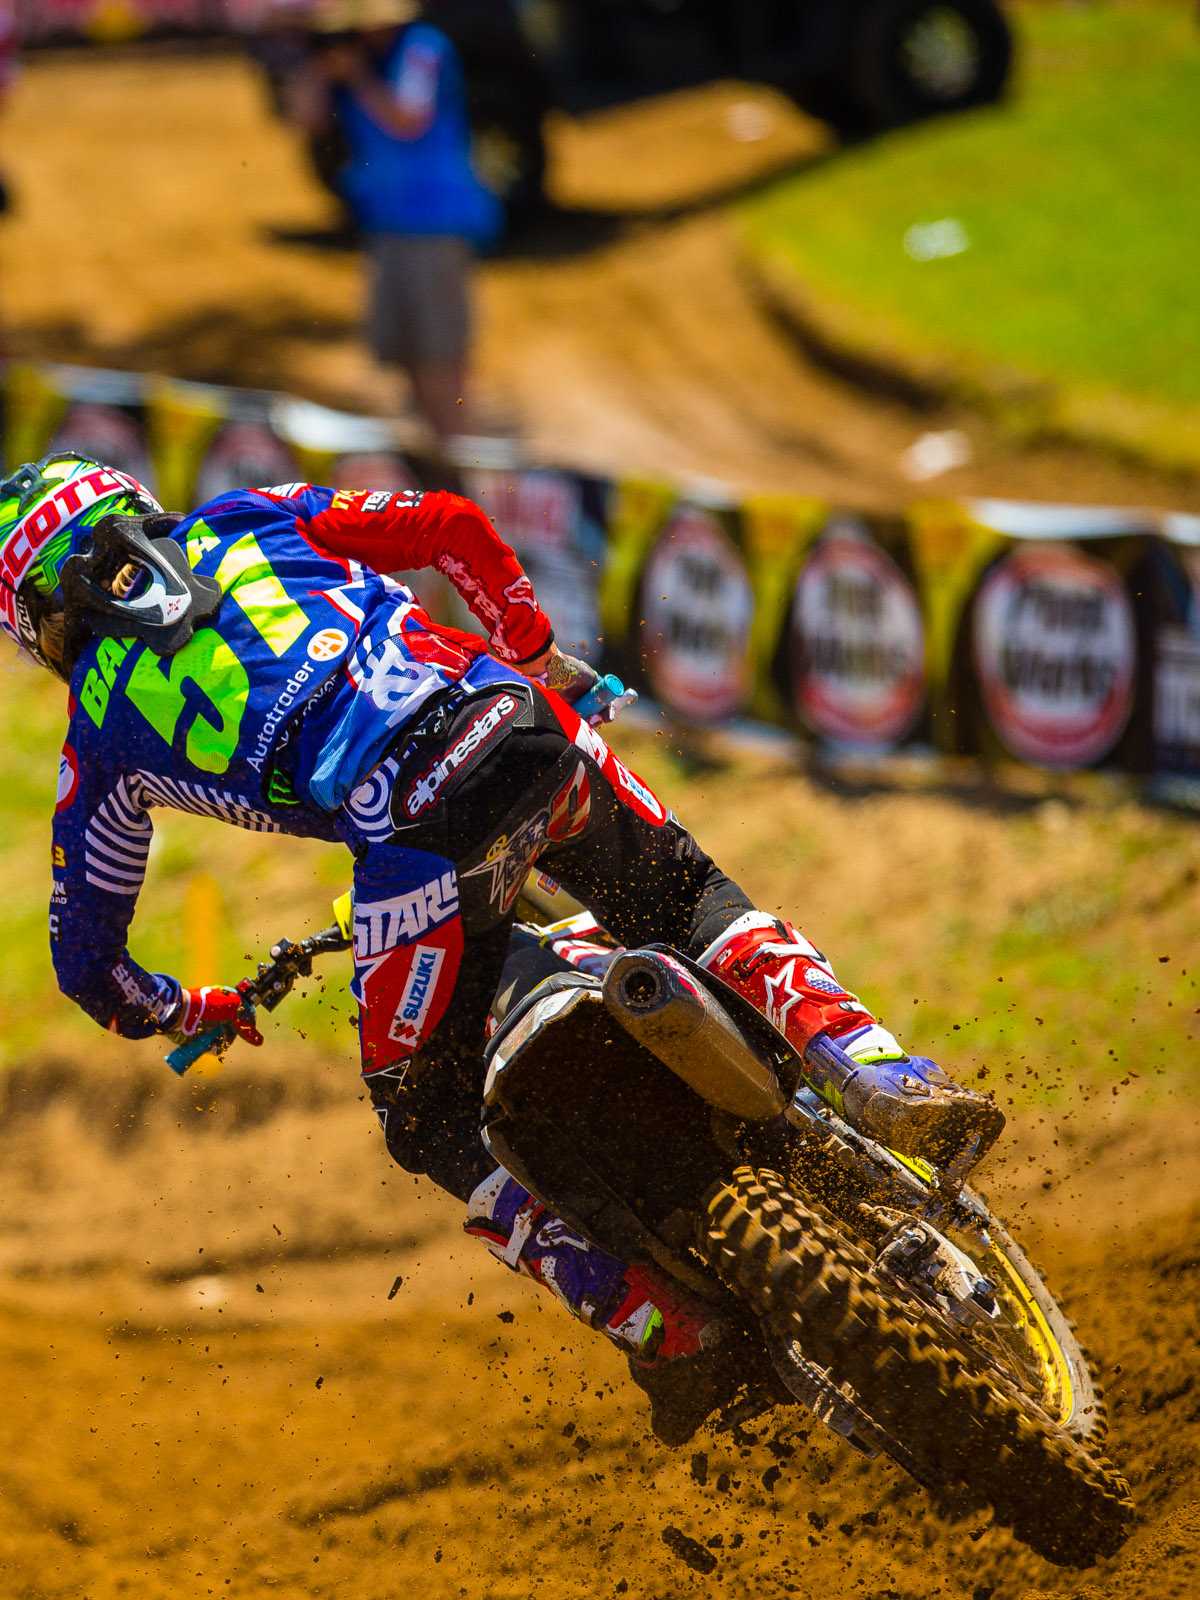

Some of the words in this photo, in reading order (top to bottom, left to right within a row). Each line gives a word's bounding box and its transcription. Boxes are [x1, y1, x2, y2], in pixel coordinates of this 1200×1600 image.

[125, 531, 311, 775] 51
[246, 661, 315, 773] Autotrader
[408, 695, 515, 815] alpinestars
[403, 952, 436, 1020] SUZUKI
